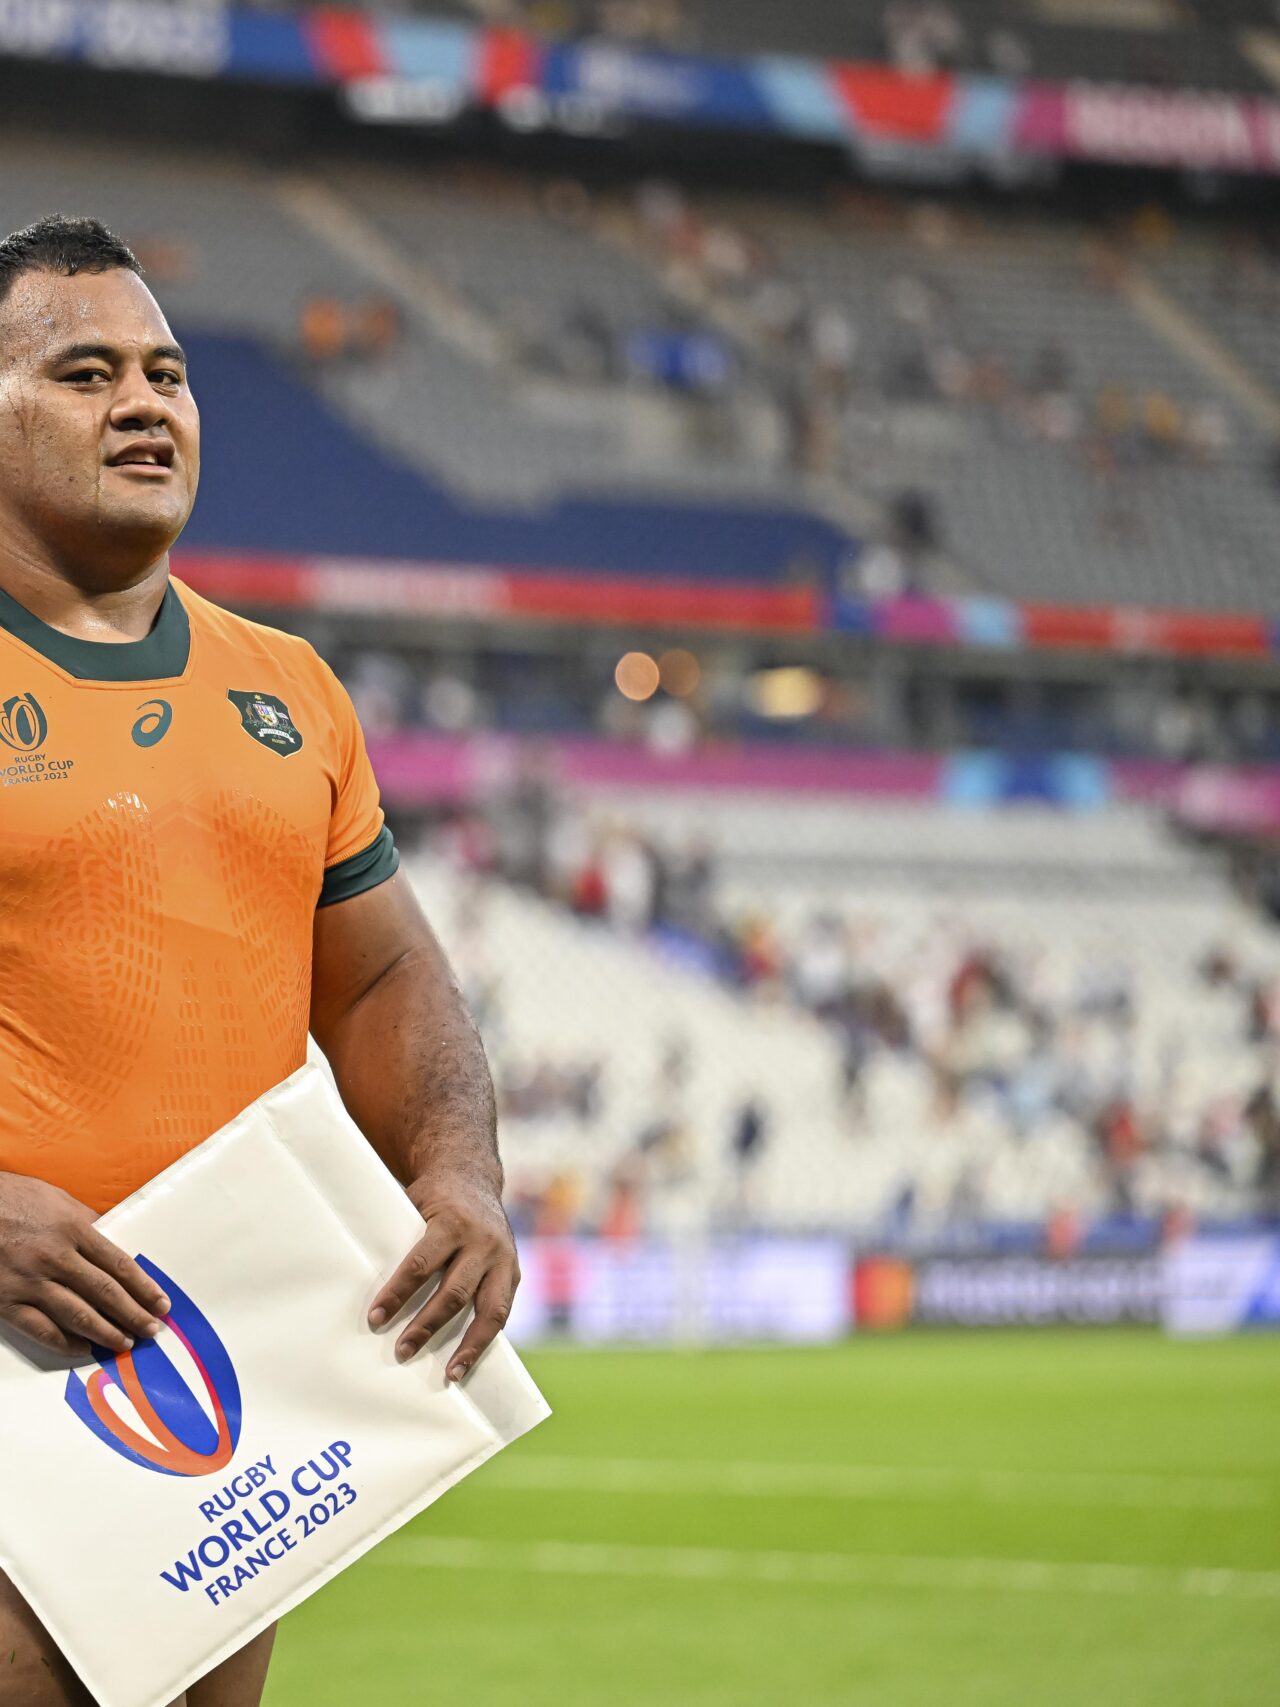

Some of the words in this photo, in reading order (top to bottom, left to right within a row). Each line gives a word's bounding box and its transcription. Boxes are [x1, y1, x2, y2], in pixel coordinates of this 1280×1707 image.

[14, 753, 47, 764] RUGBY
[43, 771, 69, 781] 2023
[47, 760, 74, 771] CUP
[198, 1454, 277, 1523] RUGBY
[159, 1489, 291, 1592] WORLD
[291, 1440, 352, 1497] CUP
[204, 1528, 298, 1607] FRANCE
[294, 1482, 357, 1539] 2023
